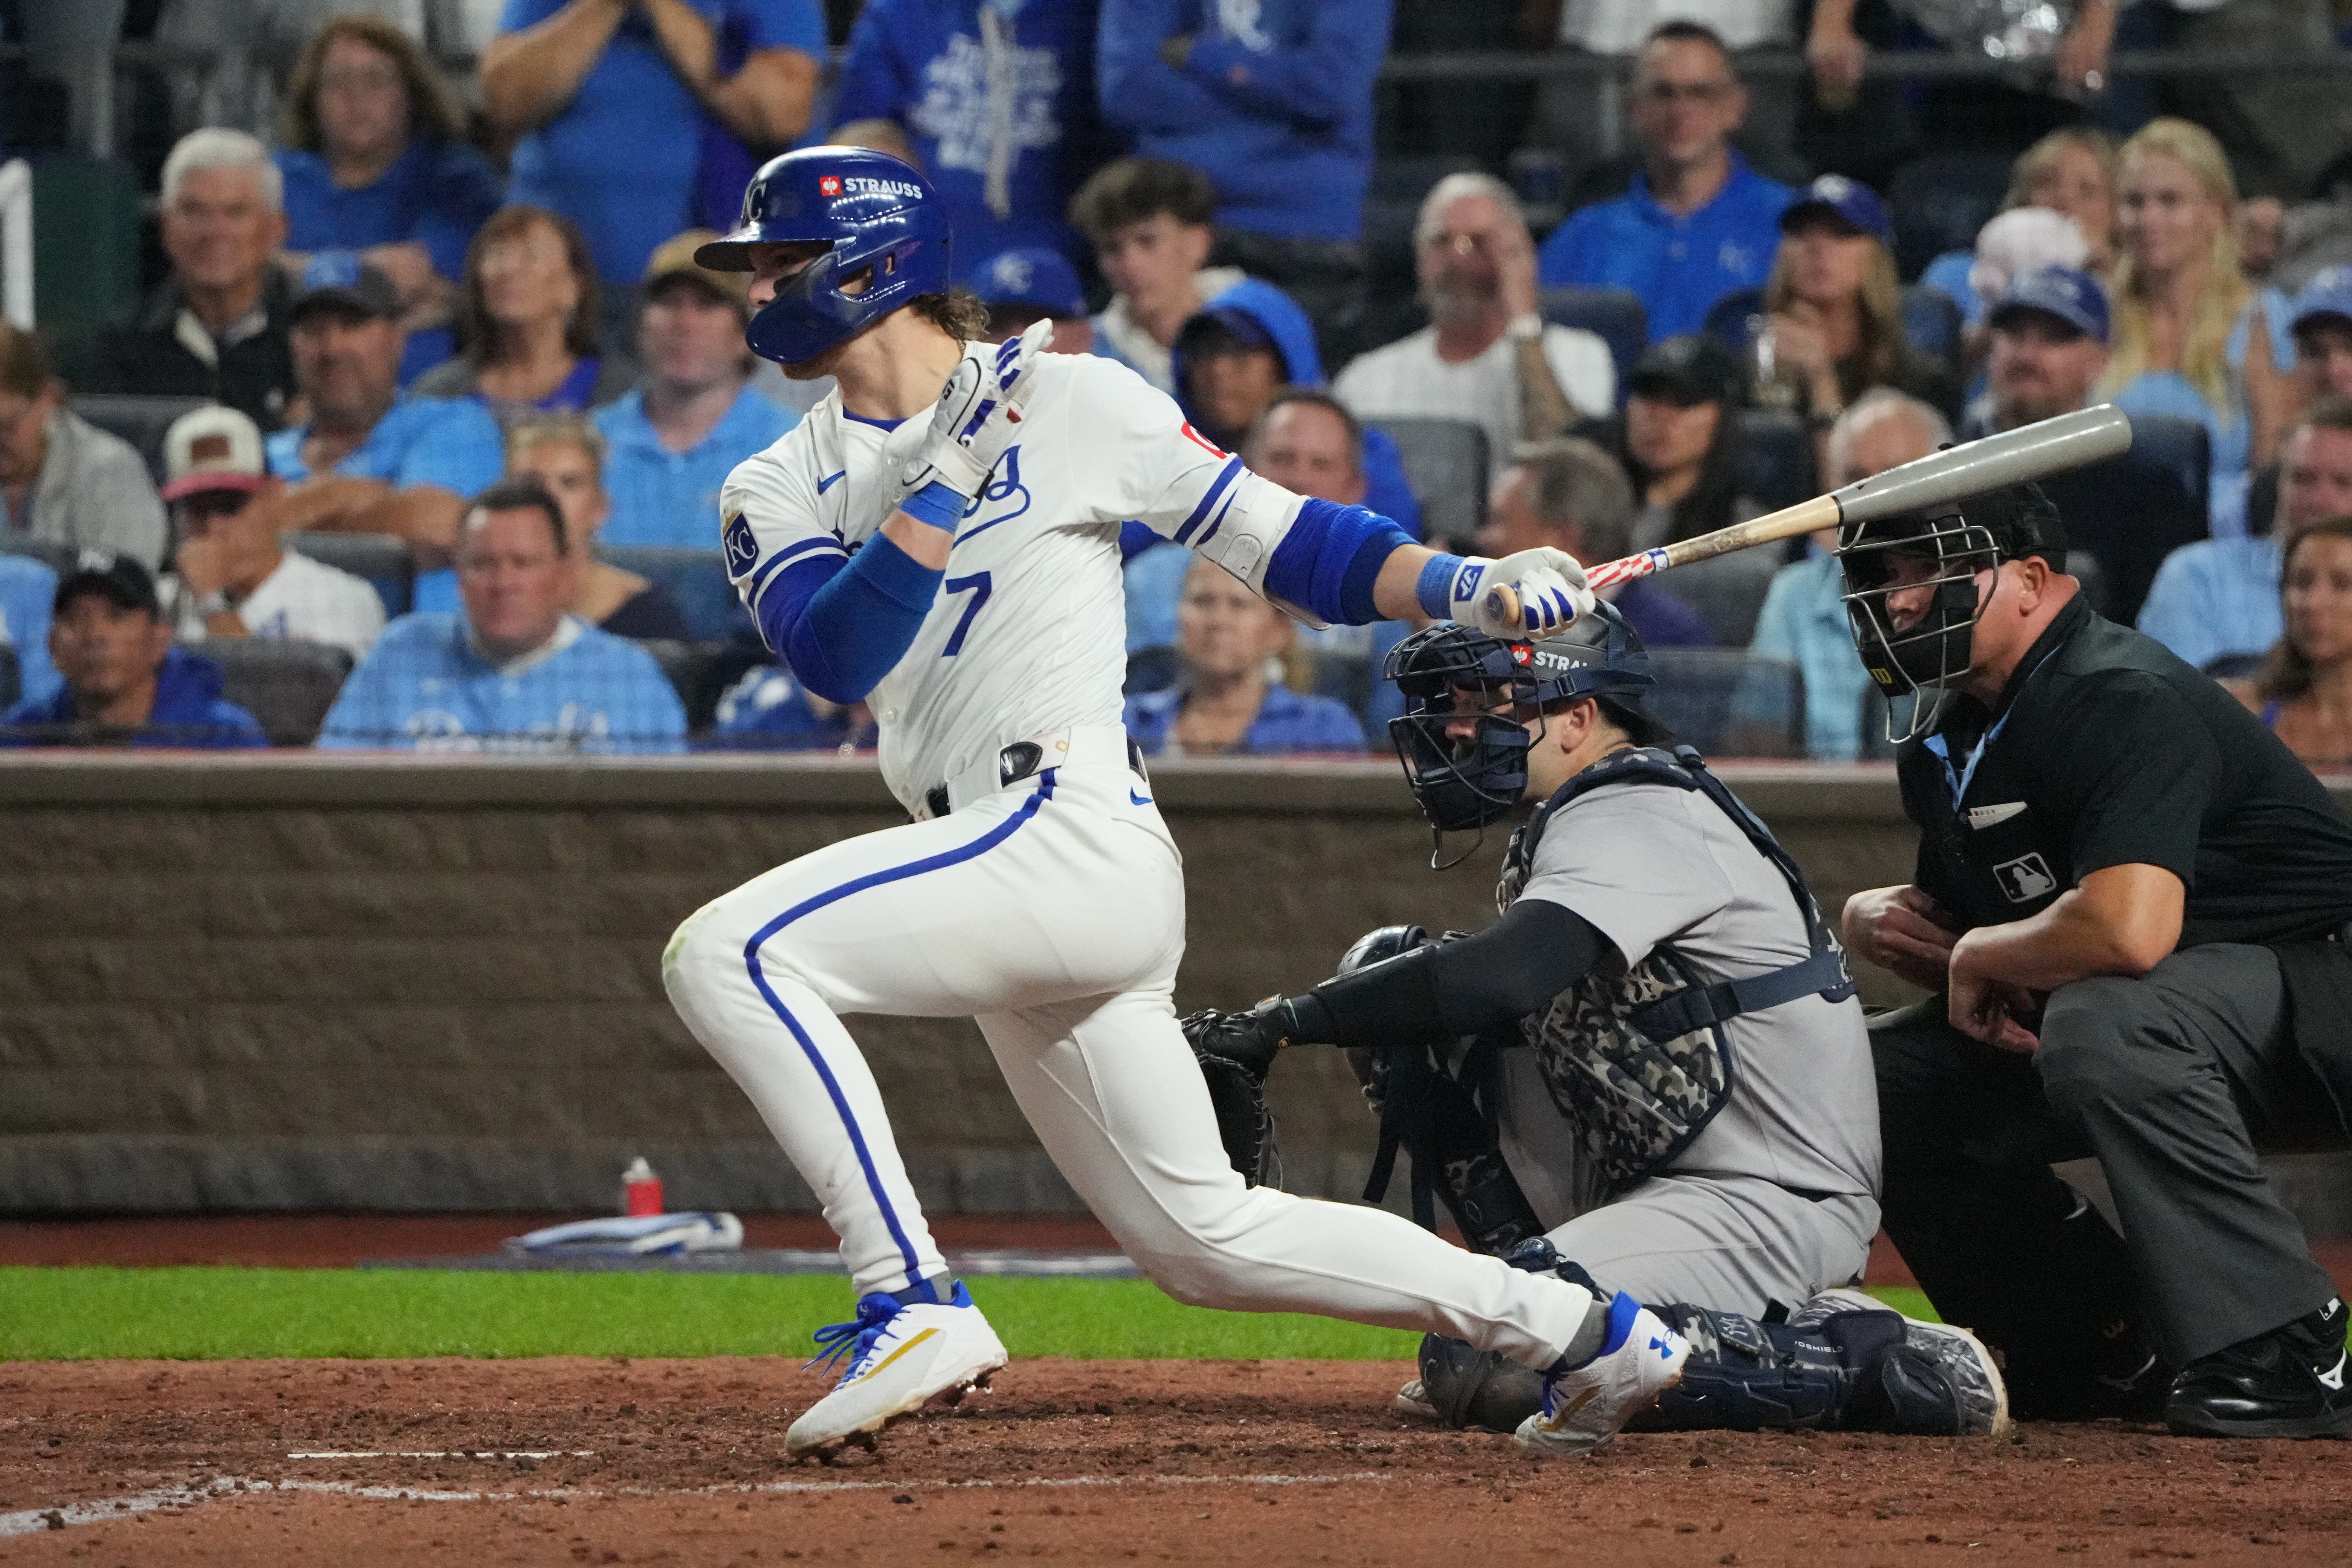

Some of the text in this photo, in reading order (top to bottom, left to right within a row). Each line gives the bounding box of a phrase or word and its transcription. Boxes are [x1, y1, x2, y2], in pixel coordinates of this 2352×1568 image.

[845, 177, 923, 200] STRAUSS
[726, 526, 756, 567] KC
[942, 571, 992, 657] 7
[1534, 651, 1588, 670] STRA
[1794, 1340, 1843, 1353] OSHIELD
